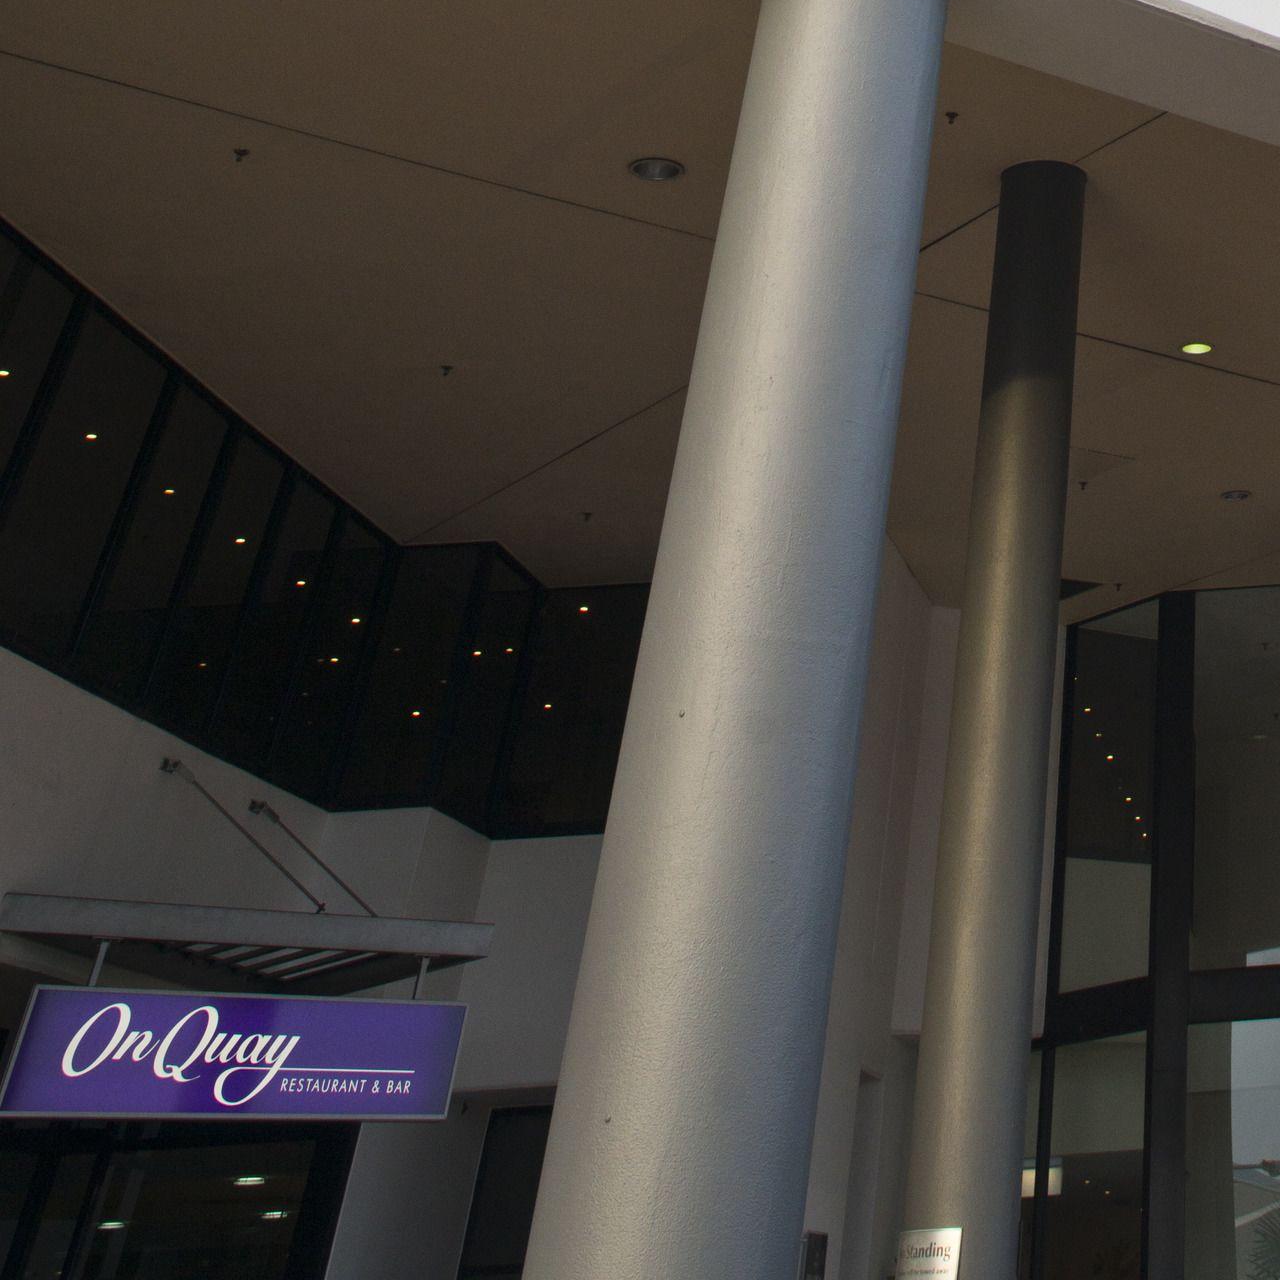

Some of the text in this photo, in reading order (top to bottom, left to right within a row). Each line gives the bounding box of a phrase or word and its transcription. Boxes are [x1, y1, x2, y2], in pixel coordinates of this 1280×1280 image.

[61, 1002, 302, 1106] On Quay
[280, 1077, 413, 1095] RESTAURANT & BAR
